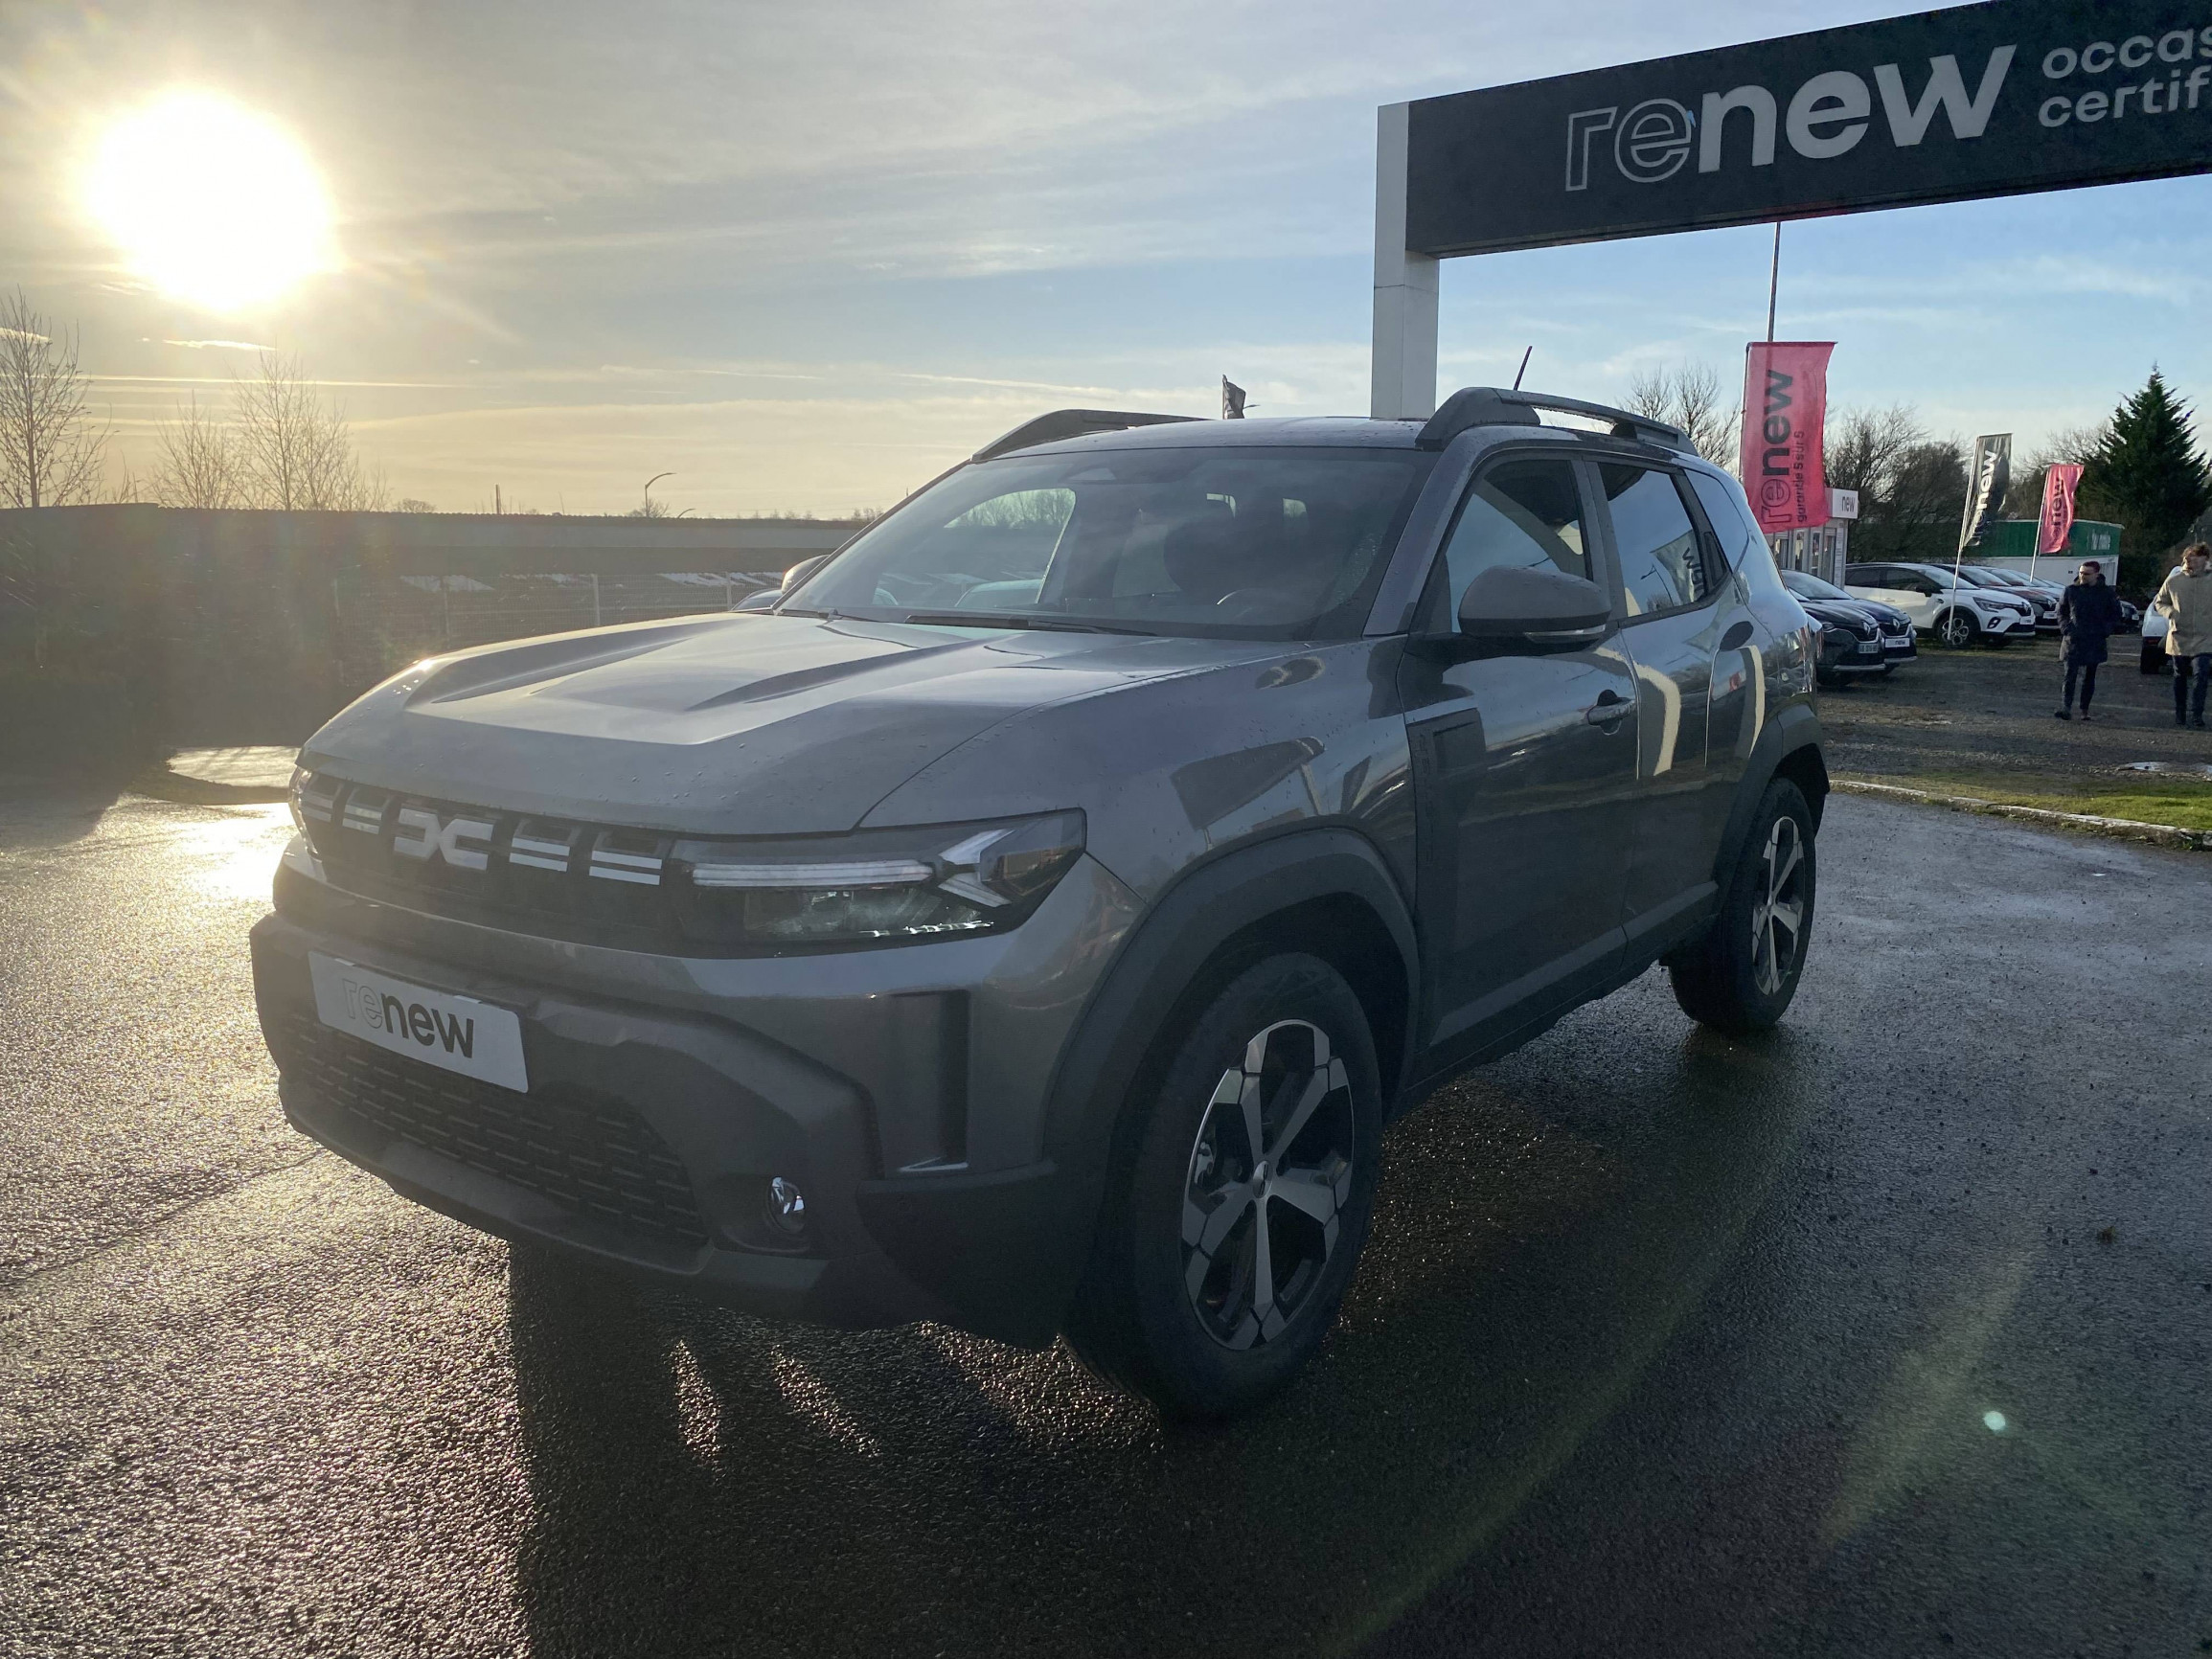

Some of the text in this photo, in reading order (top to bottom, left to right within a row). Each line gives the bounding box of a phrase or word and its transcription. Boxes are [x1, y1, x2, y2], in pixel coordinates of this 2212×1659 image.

[1565, 44, 2018, 192] renew
[2038, 64, 2212, 128] certif
[1761, 369, 1793, 524] renew
[1793, 472, 1807, 523] garantie
[341, 977, 474, 1059] renew
